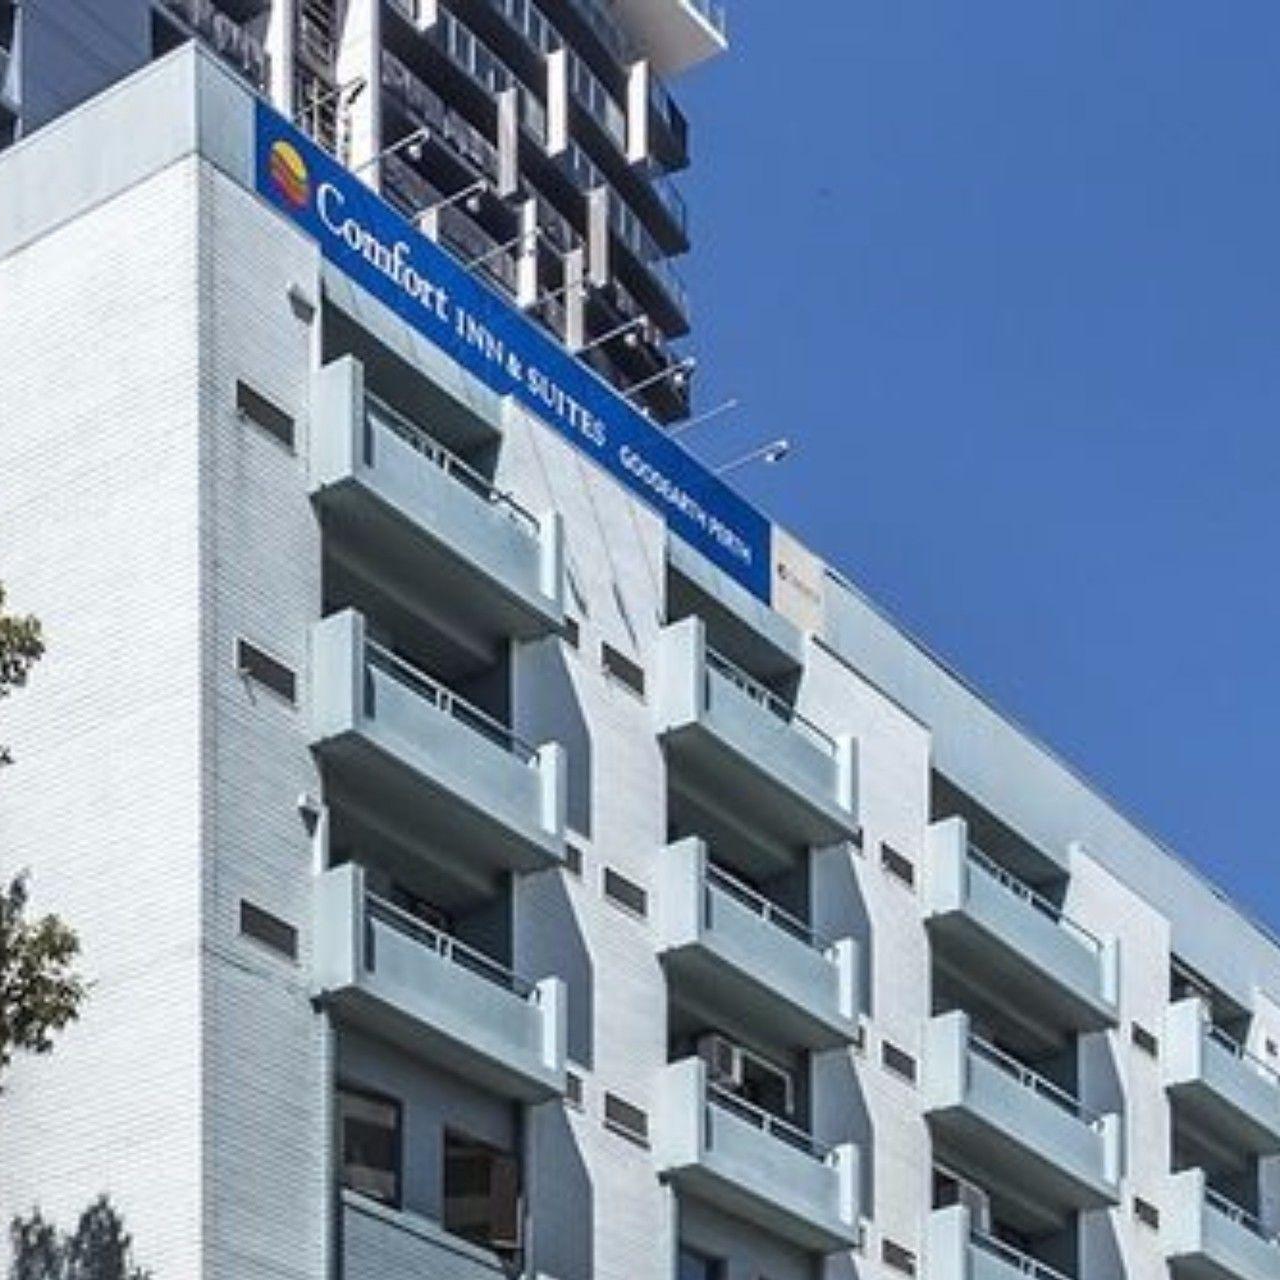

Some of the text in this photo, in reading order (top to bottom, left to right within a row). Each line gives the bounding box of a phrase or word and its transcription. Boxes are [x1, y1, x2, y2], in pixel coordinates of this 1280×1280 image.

[316, 182, 449, 323] Comfort
[454, 307, 503, 367] INN
[508, 351, 523, 383] &
[526, 366, 608, 448] SUITES
